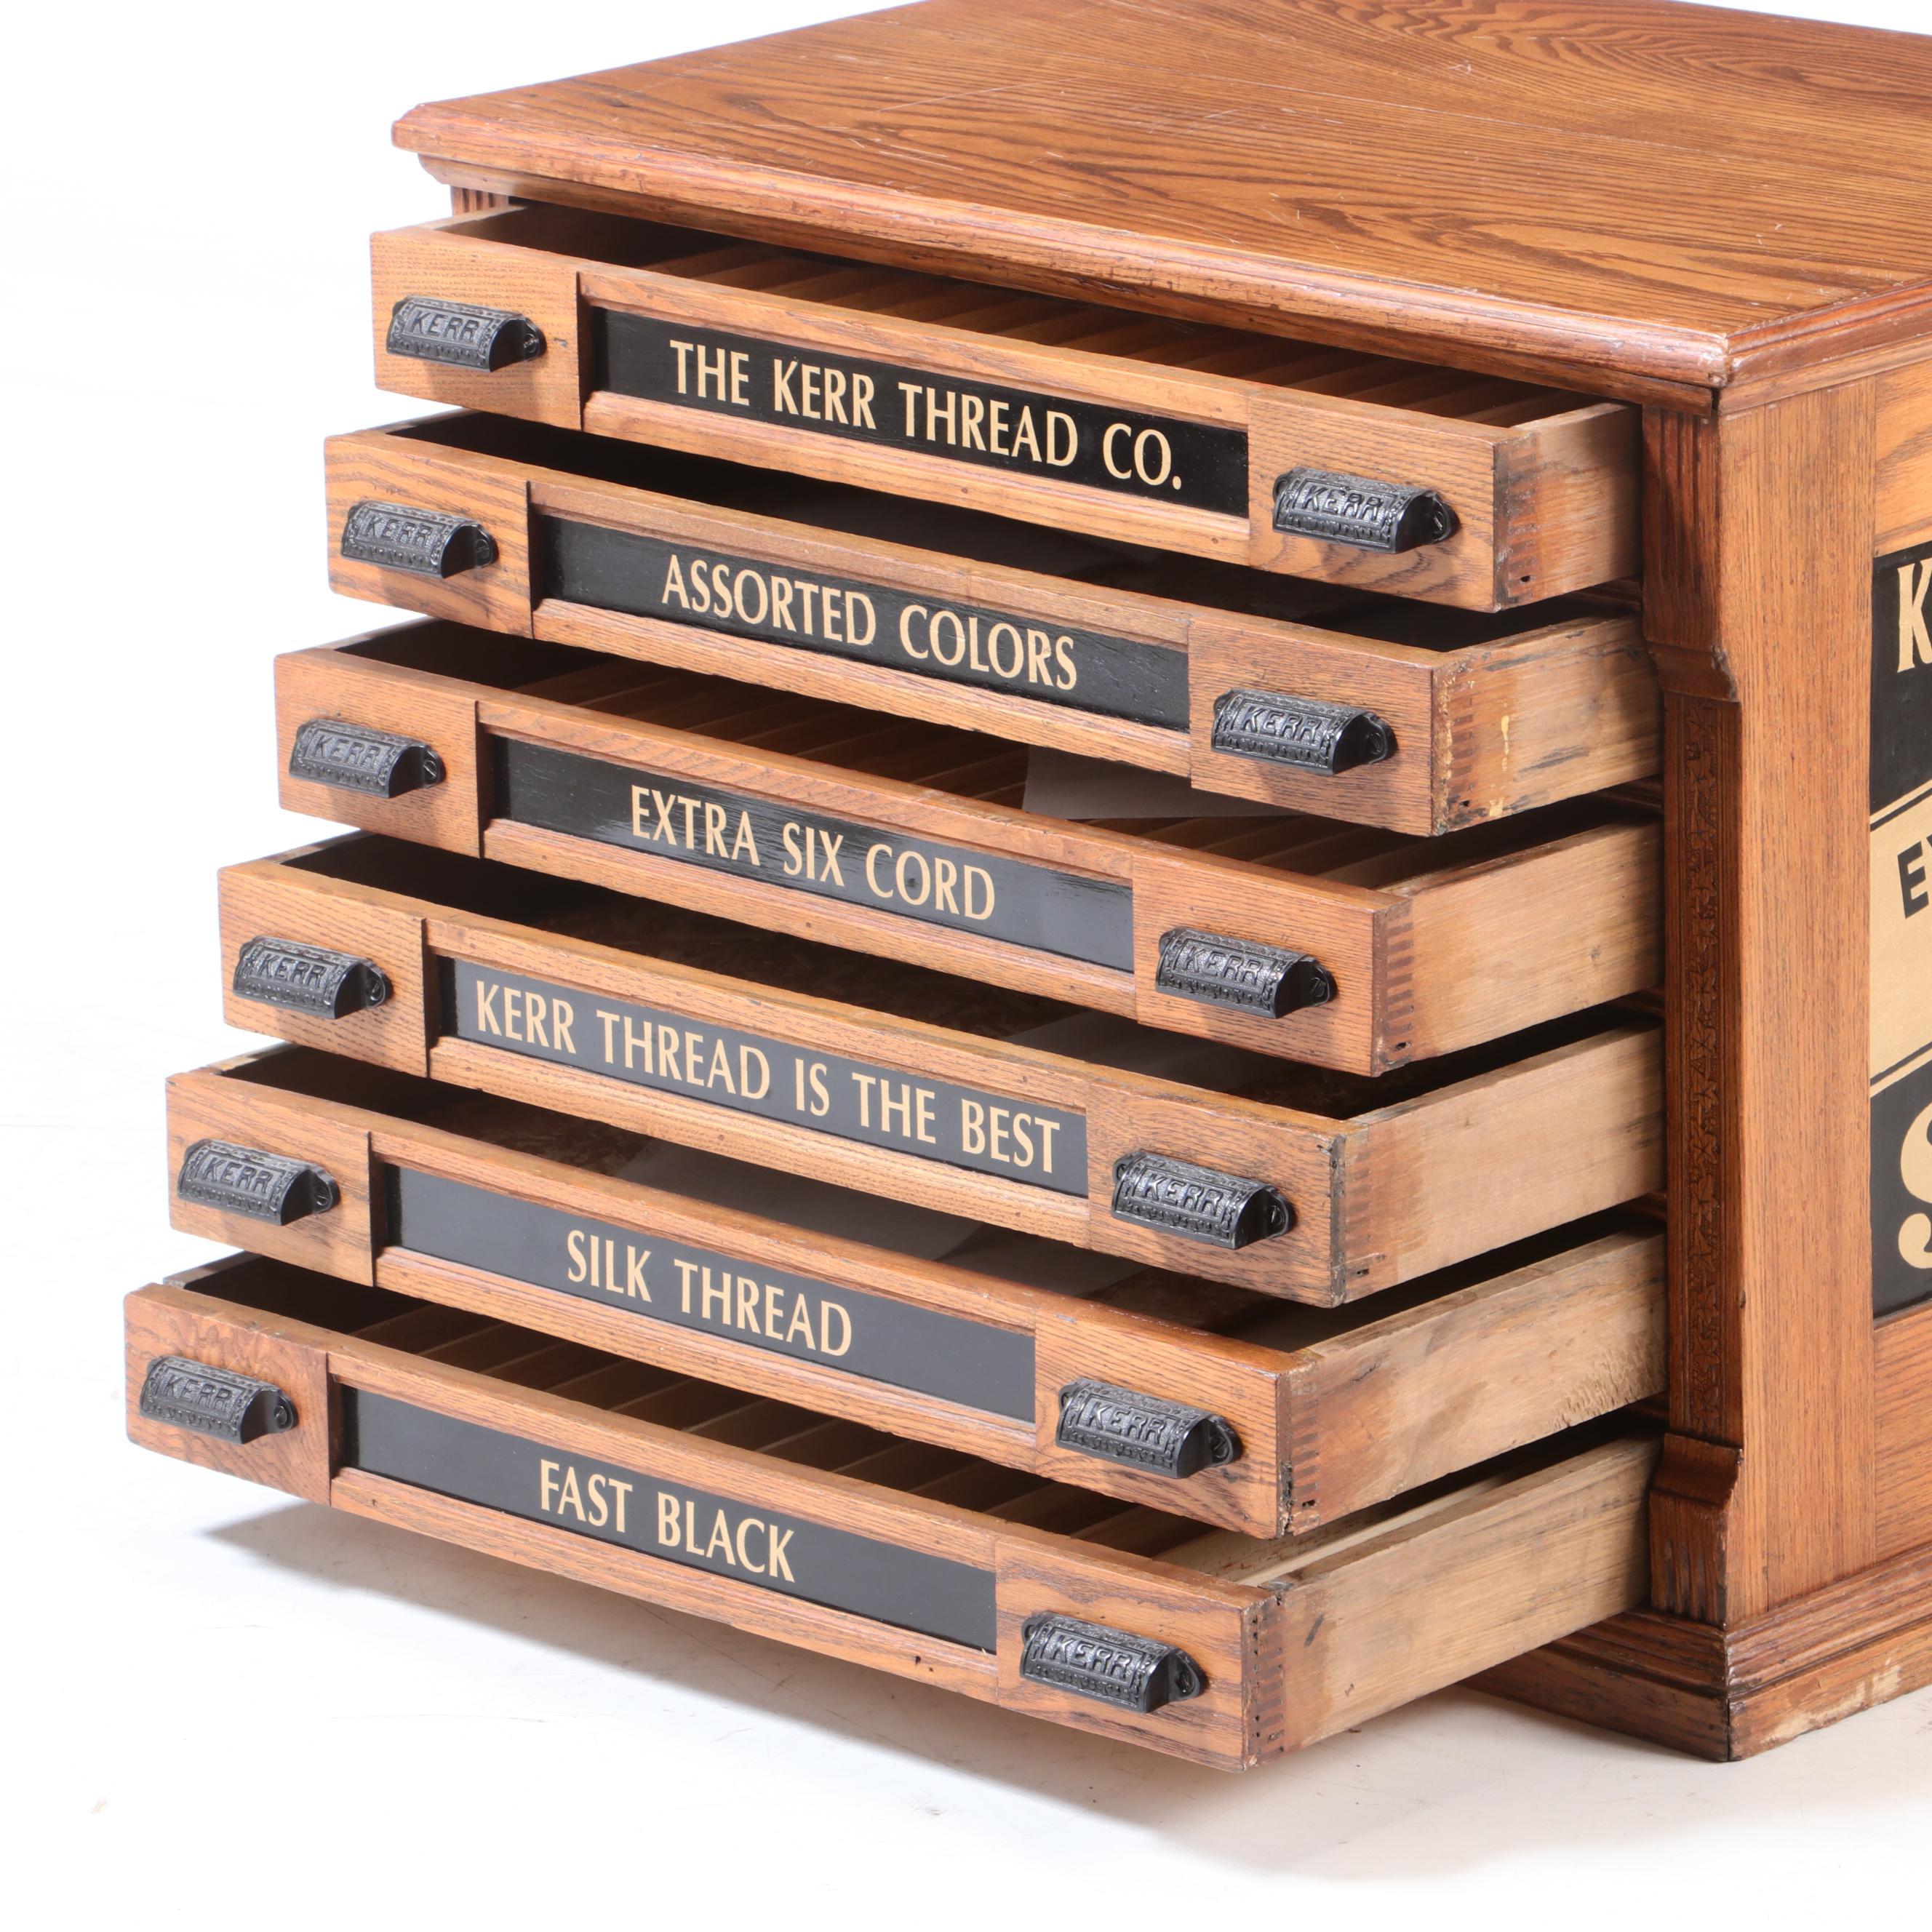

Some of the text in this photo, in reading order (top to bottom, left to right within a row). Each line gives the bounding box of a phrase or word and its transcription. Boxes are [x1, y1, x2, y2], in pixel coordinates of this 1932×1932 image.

[413, 311, 479, 340] KERR
[669, 339, 1181, 490] THE KERR THREAD CO.
[1304, 484, 1381, 522] KERR
[364, 516, 431, 546] KERR
[661, 554, 1077, 690] ASSORTED COLORS
[1241, 706, 1321, 744] KERR
[315, 734, 384, 764] KERR
[631, 784, 996, 920] EXTRA SIX CORD
[1897, 834, 1932, 919] E
[260, 951, 325, 987] KERR
[1186, 945, 1262, 986] KERR
[476, 979, 1061, 1173] KERR THREAD IS THE BEST
[204, 1156, 275, 1194] KERR
[1143, 1170, 1224, 1213] KERR
[567, 1229, 853, 1357] SILK THREAD
[164, 1374, 233, 1411] KERR
[1090, 1397, 1167, 1442] KERR
[540, 1458, 794, 1577] FAST BLACK
[1056, 1629, 1130, 1673] KERR
